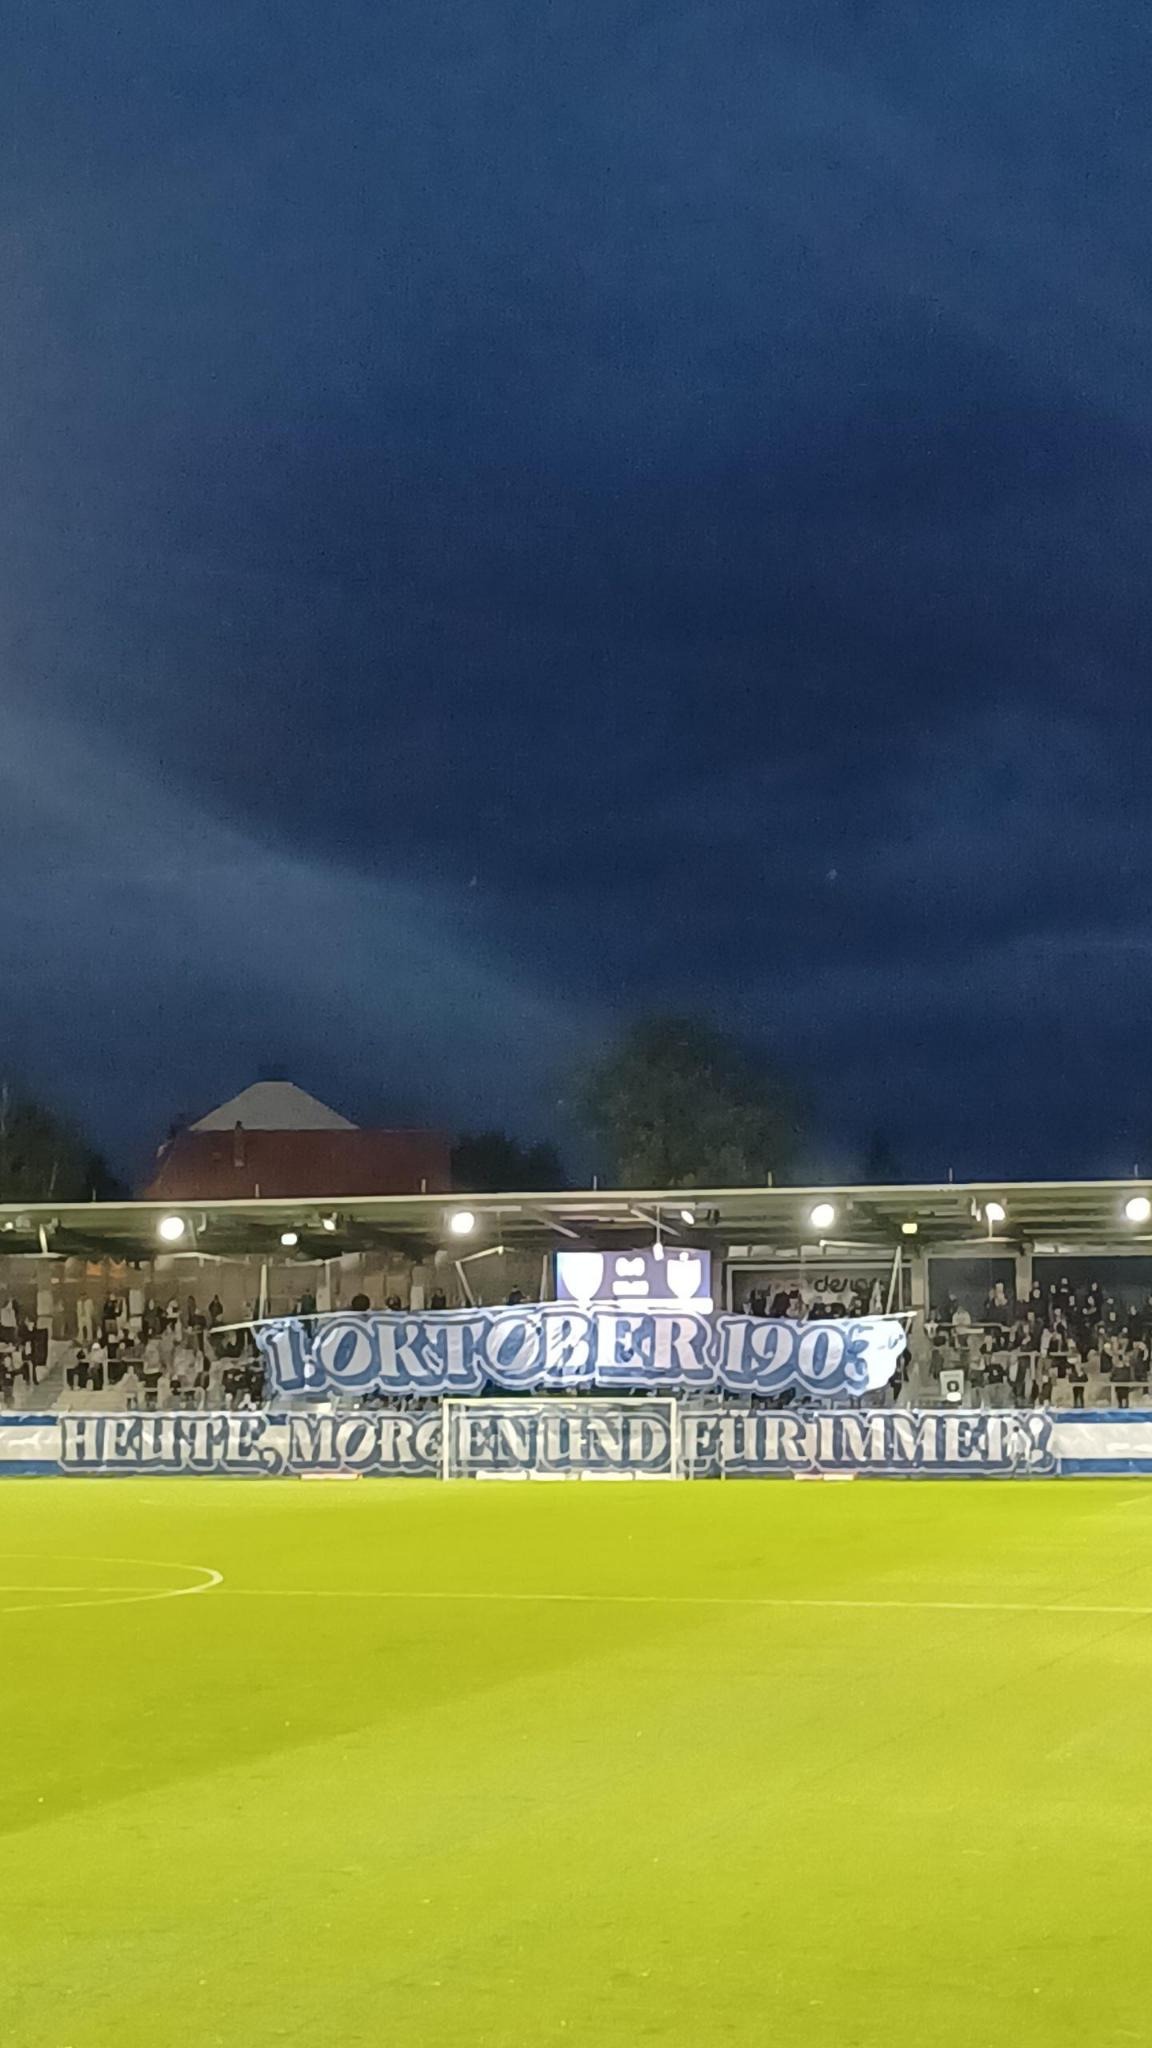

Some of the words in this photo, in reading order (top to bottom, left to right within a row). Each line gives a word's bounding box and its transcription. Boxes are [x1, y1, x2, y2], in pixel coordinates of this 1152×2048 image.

[319, 1311, 706, 1380] OKTOBER
[290, 1417, 533, 1464] MORGEN
[545, 1415, 668, 1463] UND
